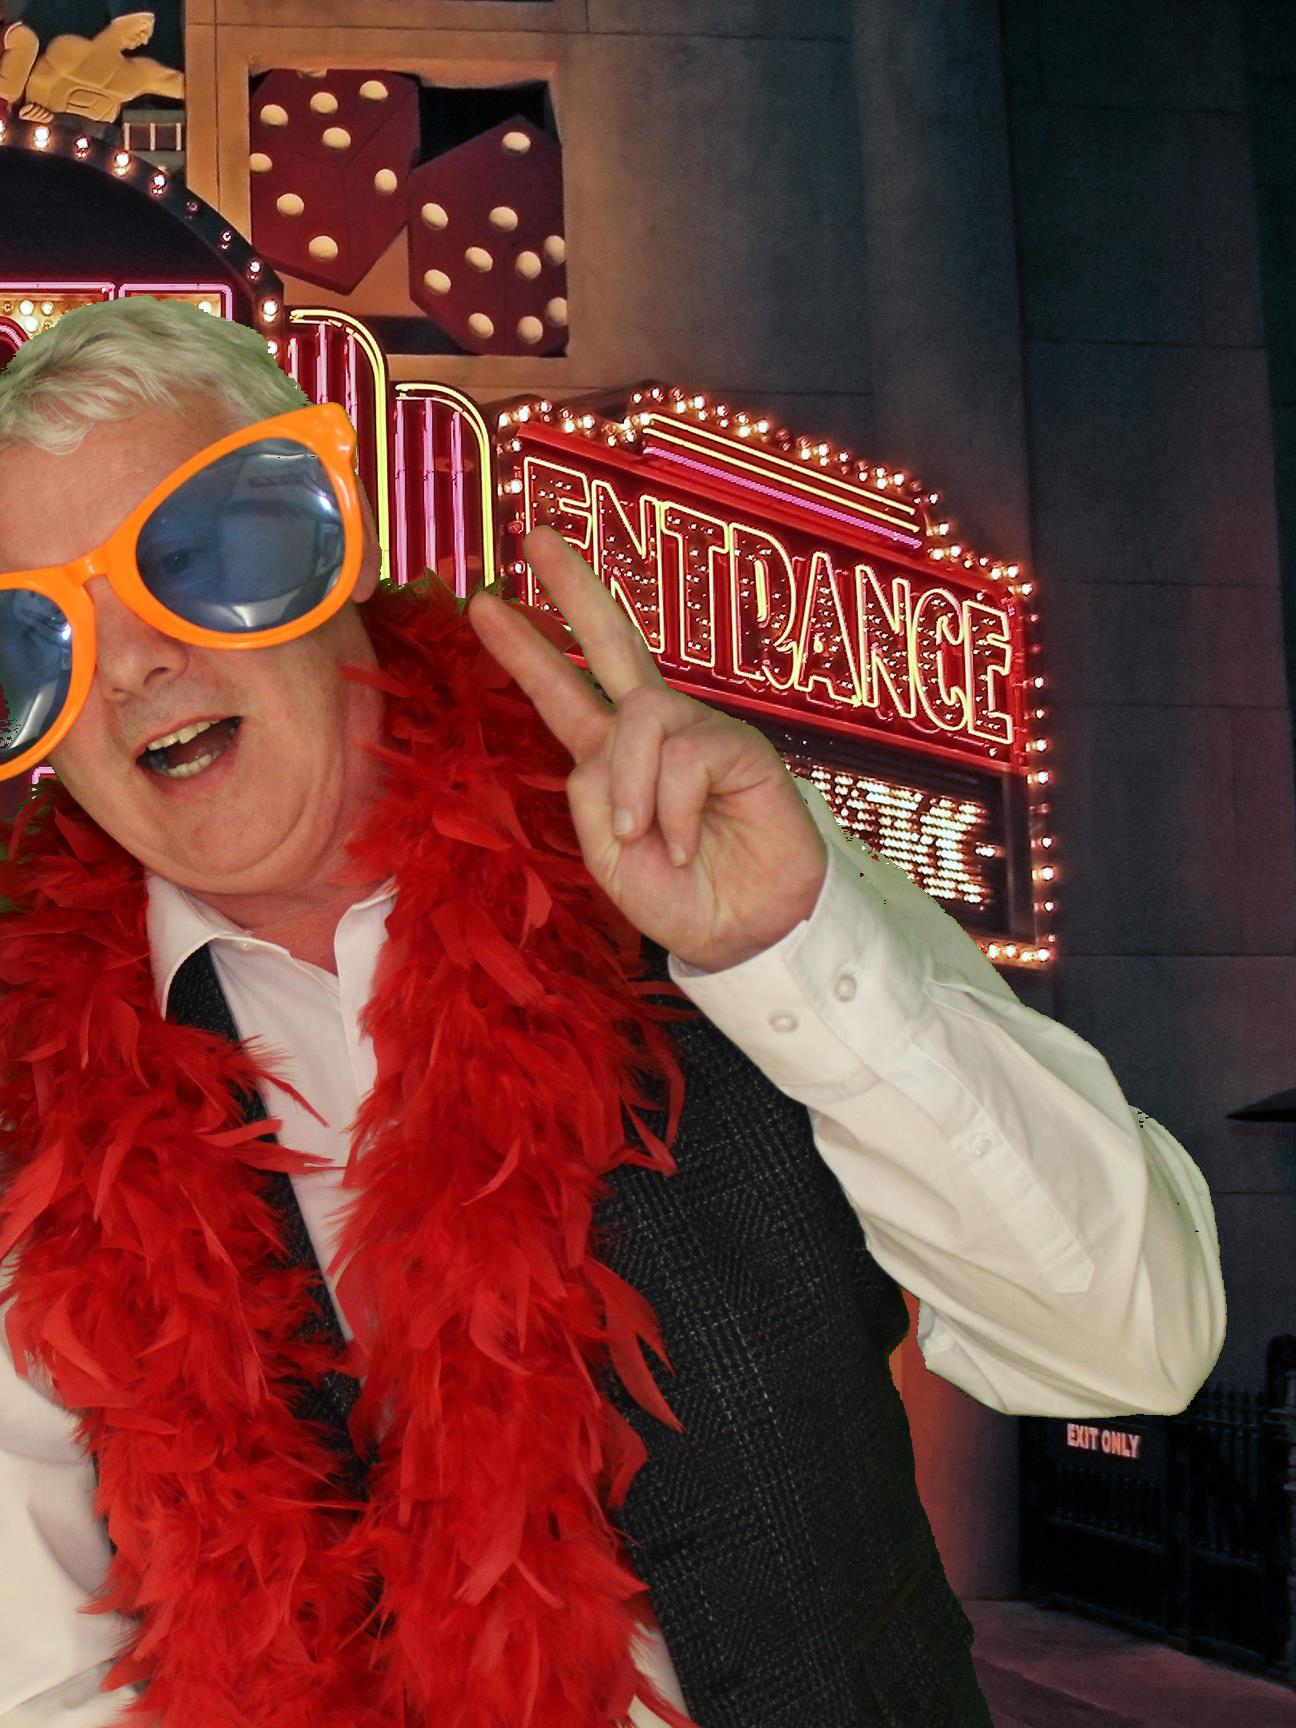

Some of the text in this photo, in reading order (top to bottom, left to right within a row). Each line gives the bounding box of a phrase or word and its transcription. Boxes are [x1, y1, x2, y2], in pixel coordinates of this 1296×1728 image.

[523, 456, 1014, 744] ENTRANCE
[1067, 1422, 1141, 1459] EXIT ONLY
